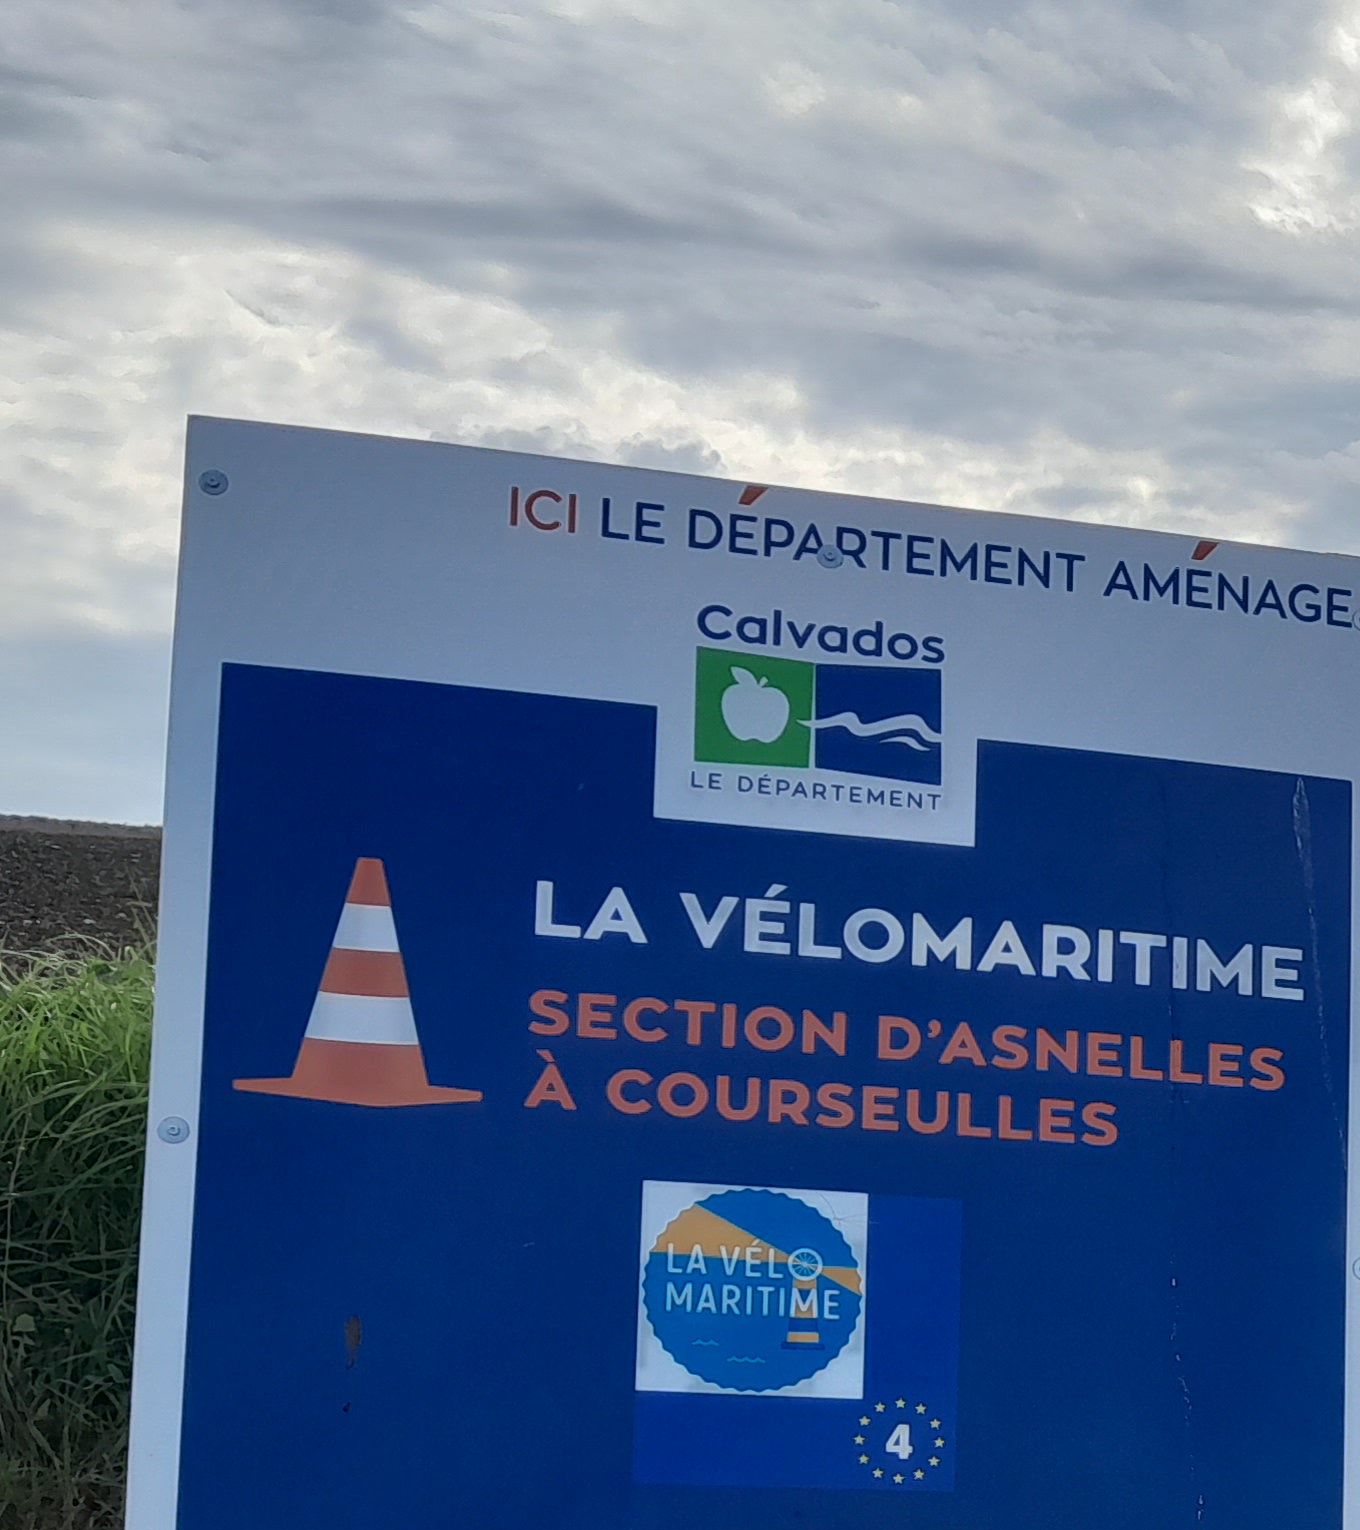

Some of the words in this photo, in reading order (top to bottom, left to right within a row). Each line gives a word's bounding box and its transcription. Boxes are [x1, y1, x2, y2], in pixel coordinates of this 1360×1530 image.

[509, 486, 577, 534] ICI
[602, 497, 664, 545] LE
[689, 486, 1085, 593] DÉPARTEMENT
[1103, 541, 1353, 629] AMÉNAGE
[697, 605, 946, 663] Calvados
[690, 770, 721, 791] LE
[736, 771, 943, 810] DÉPARTEMENT
[534, 880, 648, 945] LA
[679, 885, 1305, 1001] VÉLOMARITIME
[527, 989, 847, 1057] SECTION
[524, 1050, 576, 1111] À
[607, 1070, 1118, 1146] COURSEULLES
[665, 1242, 708, 1275] LA
[720, 1238, 823, 1281] VÉLO
[665, 1281, 841, 1320] MARITIME
[885, 1424, 913, 1460] 4
